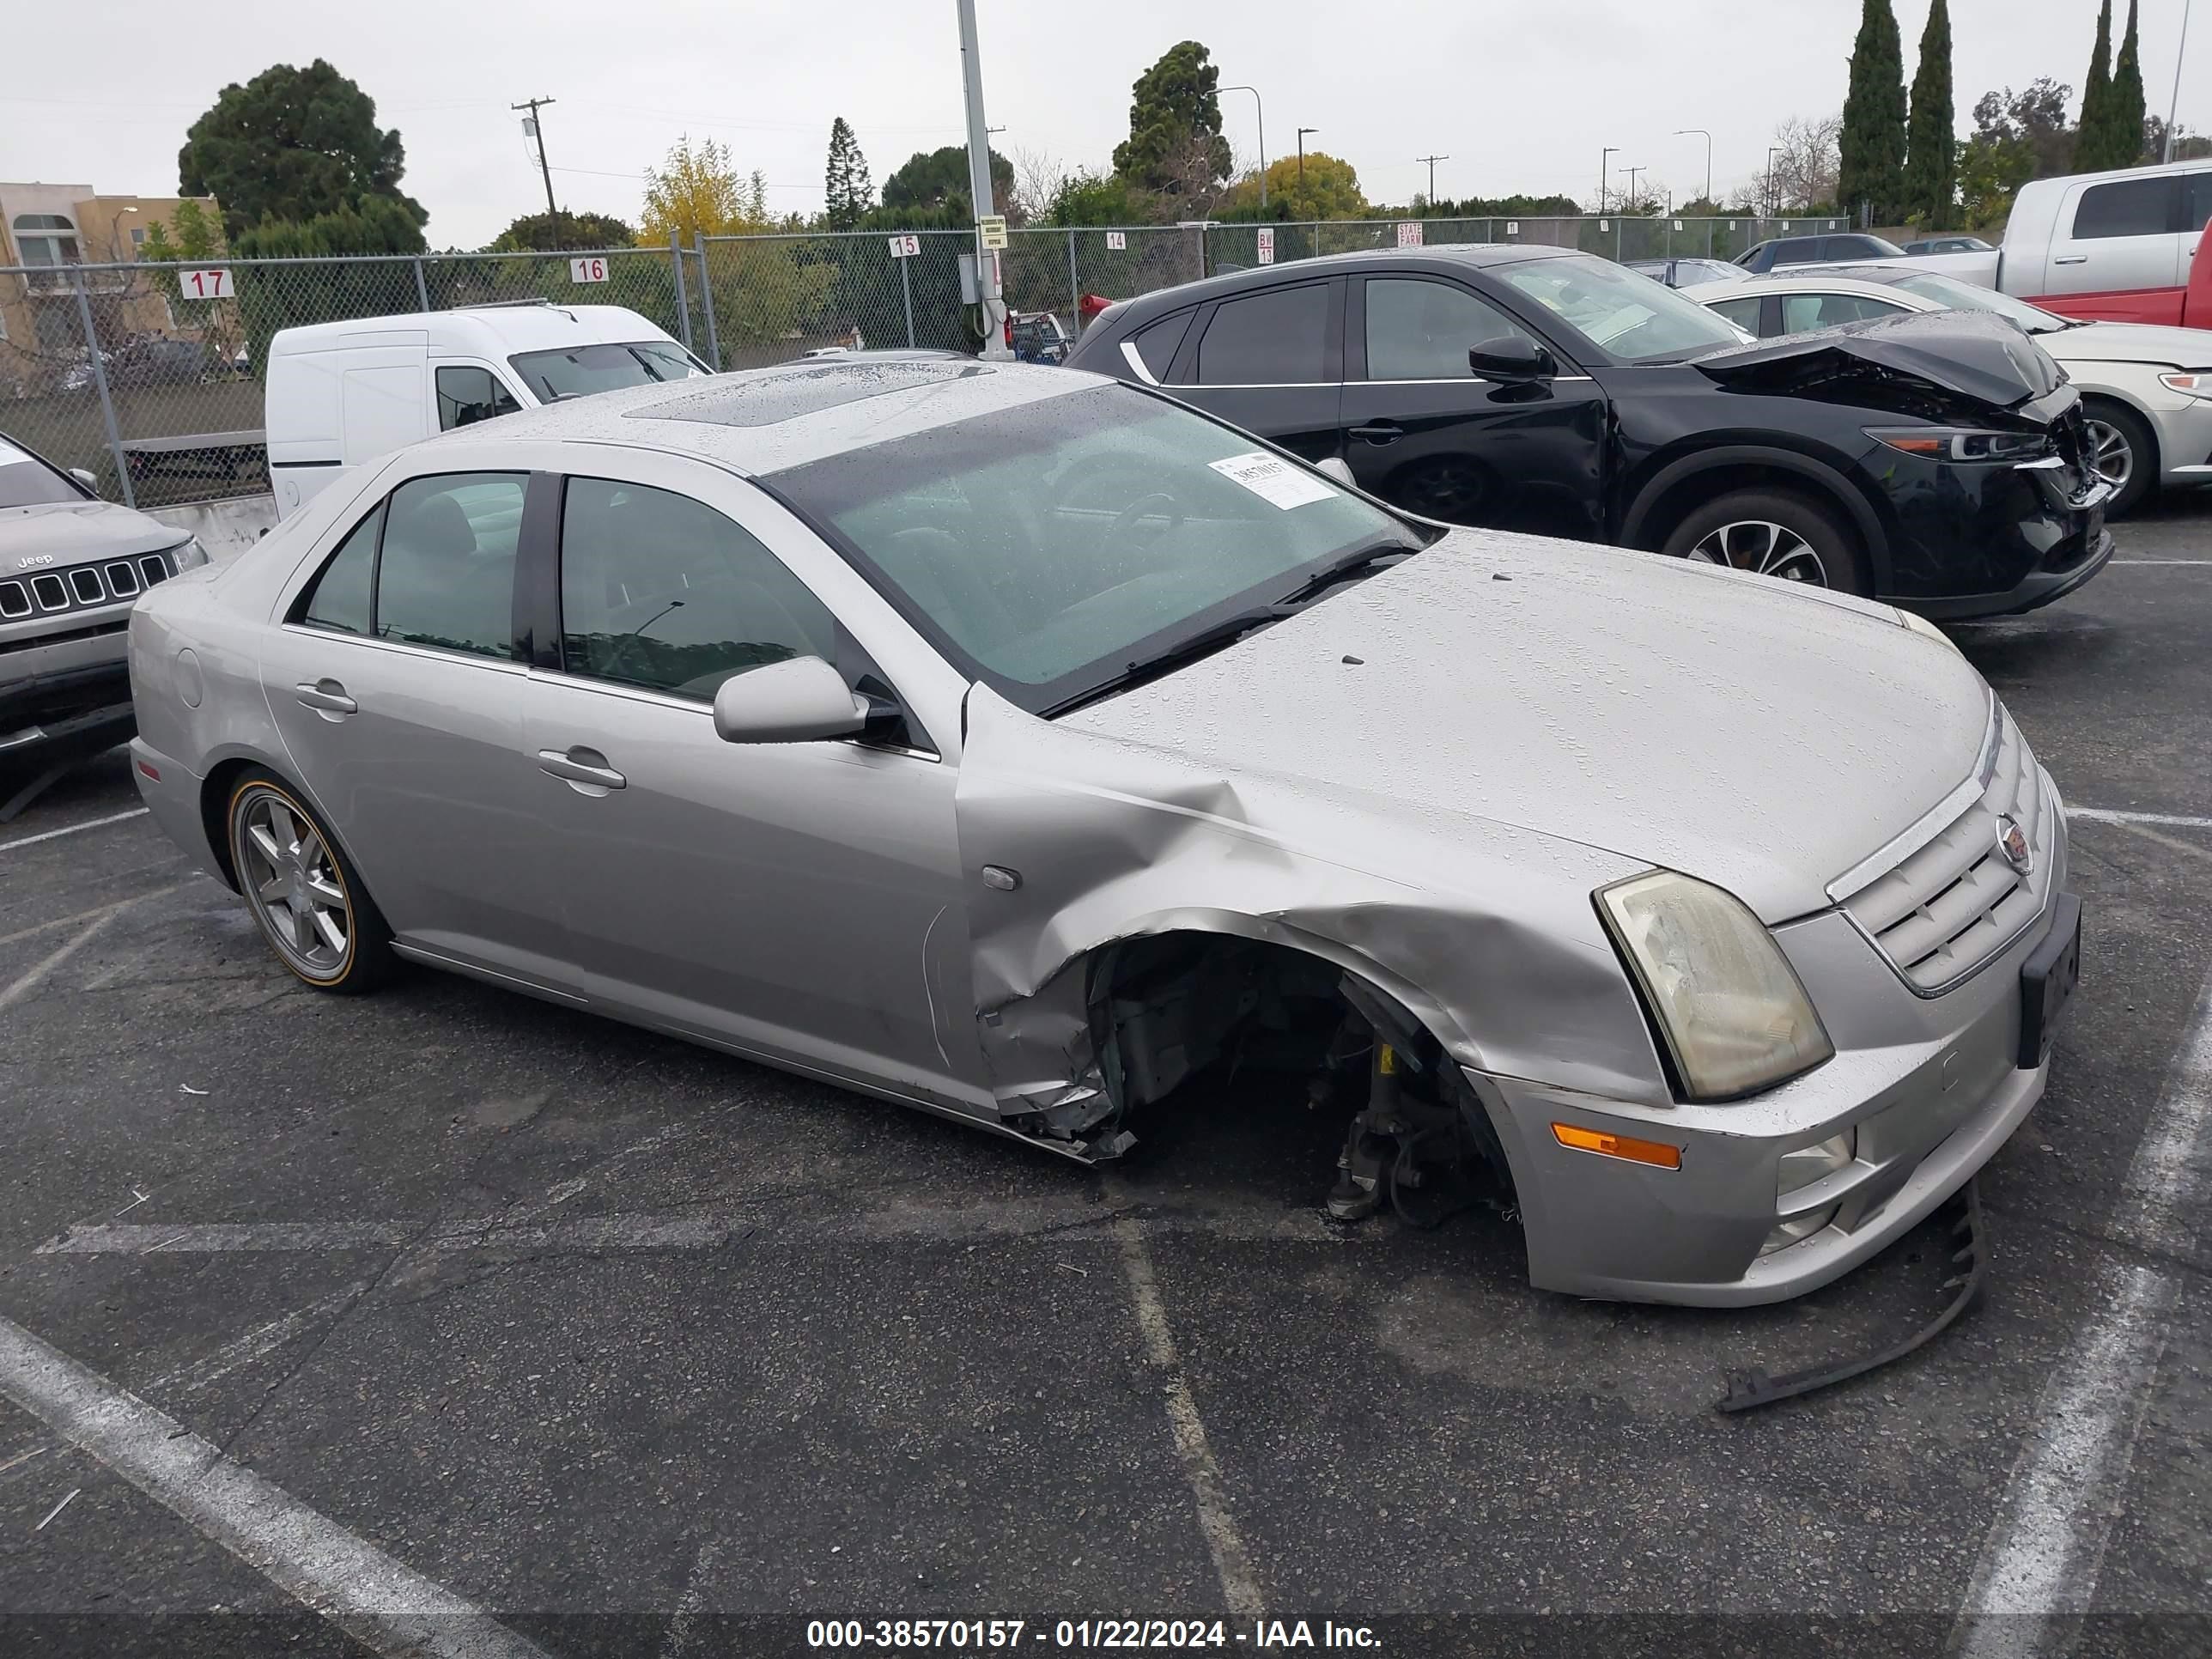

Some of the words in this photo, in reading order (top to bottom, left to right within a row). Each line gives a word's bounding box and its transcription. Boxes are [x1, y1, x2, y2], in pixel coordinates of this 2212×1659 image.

[1400, 223, 1422, 234] STATE
[895, 237, 915, 255] 15
[1110, 233, 1123, 248] 14
[1260, 234, 1272, 246] BW
[1401, 234, 1421, 246] FARM
[1261, 249, 1272, 262] 13
[579, 259, 603, 281] 16
[191, 271, 223, 296] 17
[1233, 462, 1287, 482] 38570157
[17, 554, 53, 568] Jeep
